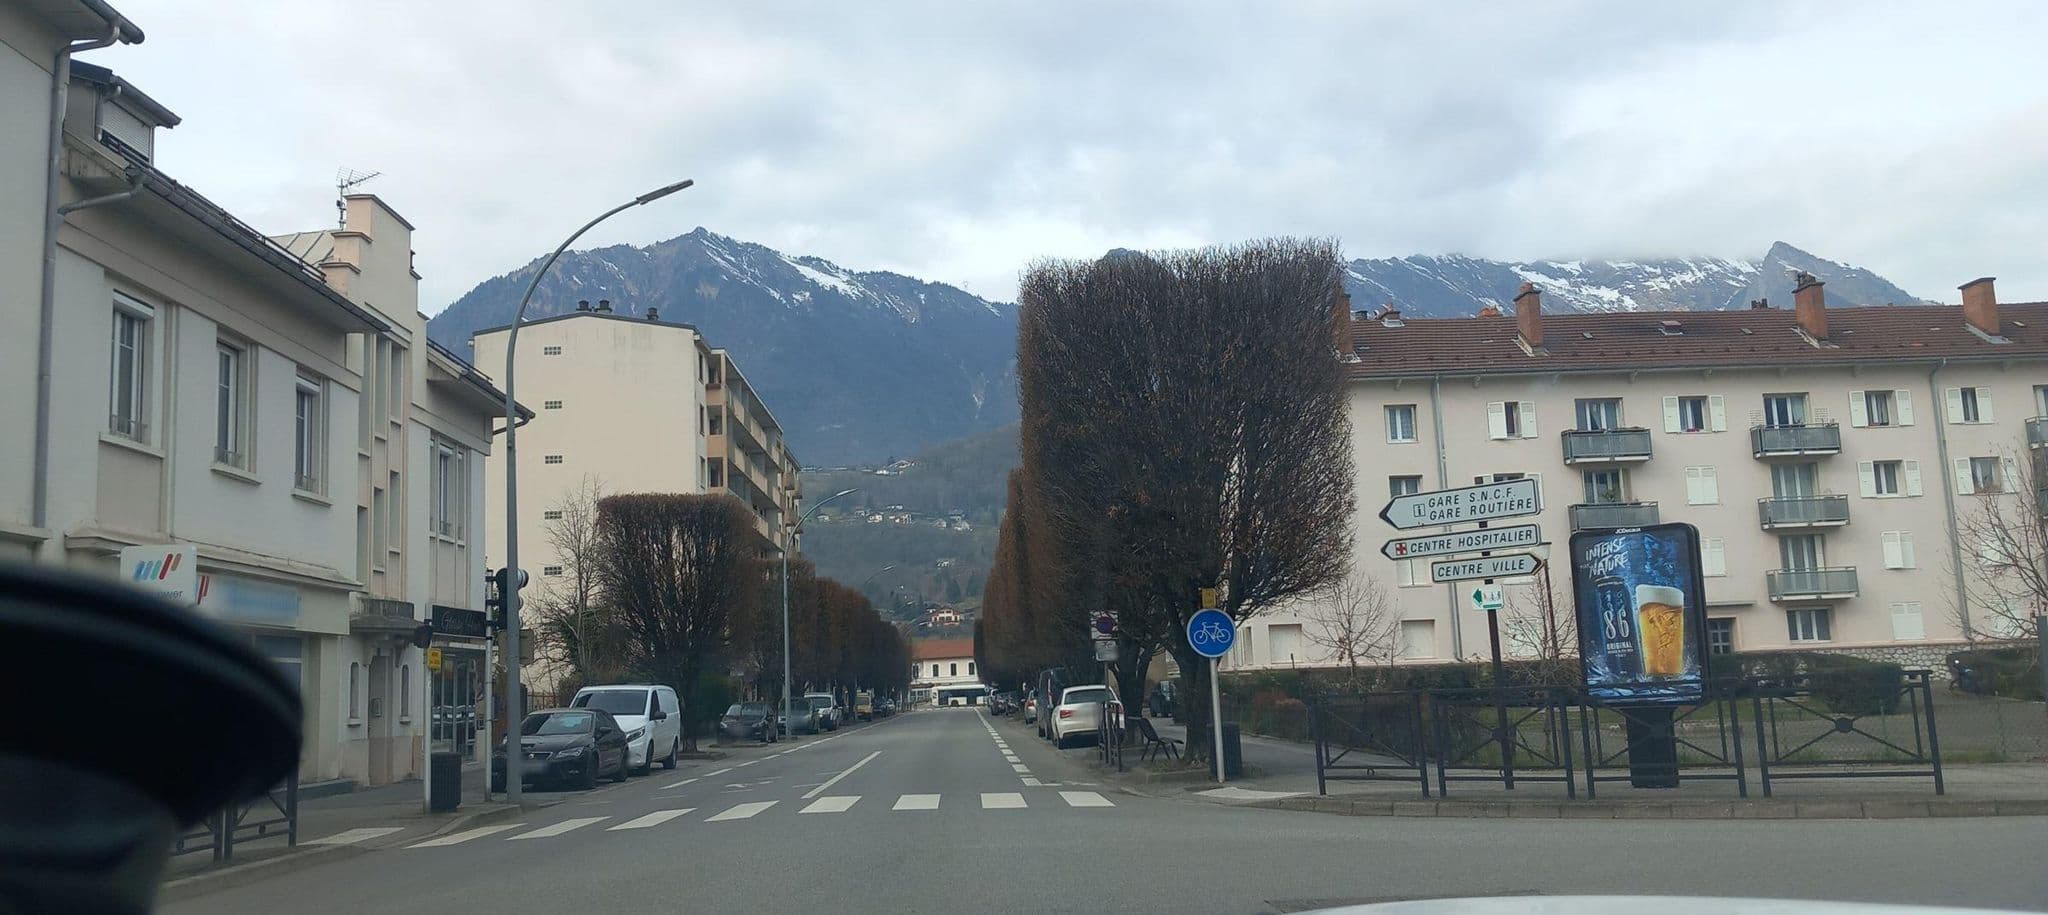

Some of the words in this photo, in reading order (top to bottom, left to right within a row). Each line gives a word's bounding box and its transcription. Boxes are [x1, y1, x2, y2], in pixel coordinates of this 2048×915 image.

[1428, 494, 1460, 508] GARE
[1469, 487, 1516, 503] S.N.C.F.
[1429, 507, 1461, 521] GARE
[1470, 498, 1532, 515] ROUTIÈRE
[1410, 538, 1452, 553] CENTRE
[1458, 529, 1533, 547] HOSPITALIER
[1585, 536, 1626, 561] INTENSE
[1437, 563, 1483, 577] CENTRE
[1492, 559, 1525, 572] VILLE
[1588, 550, 1628, 579] NATURE
